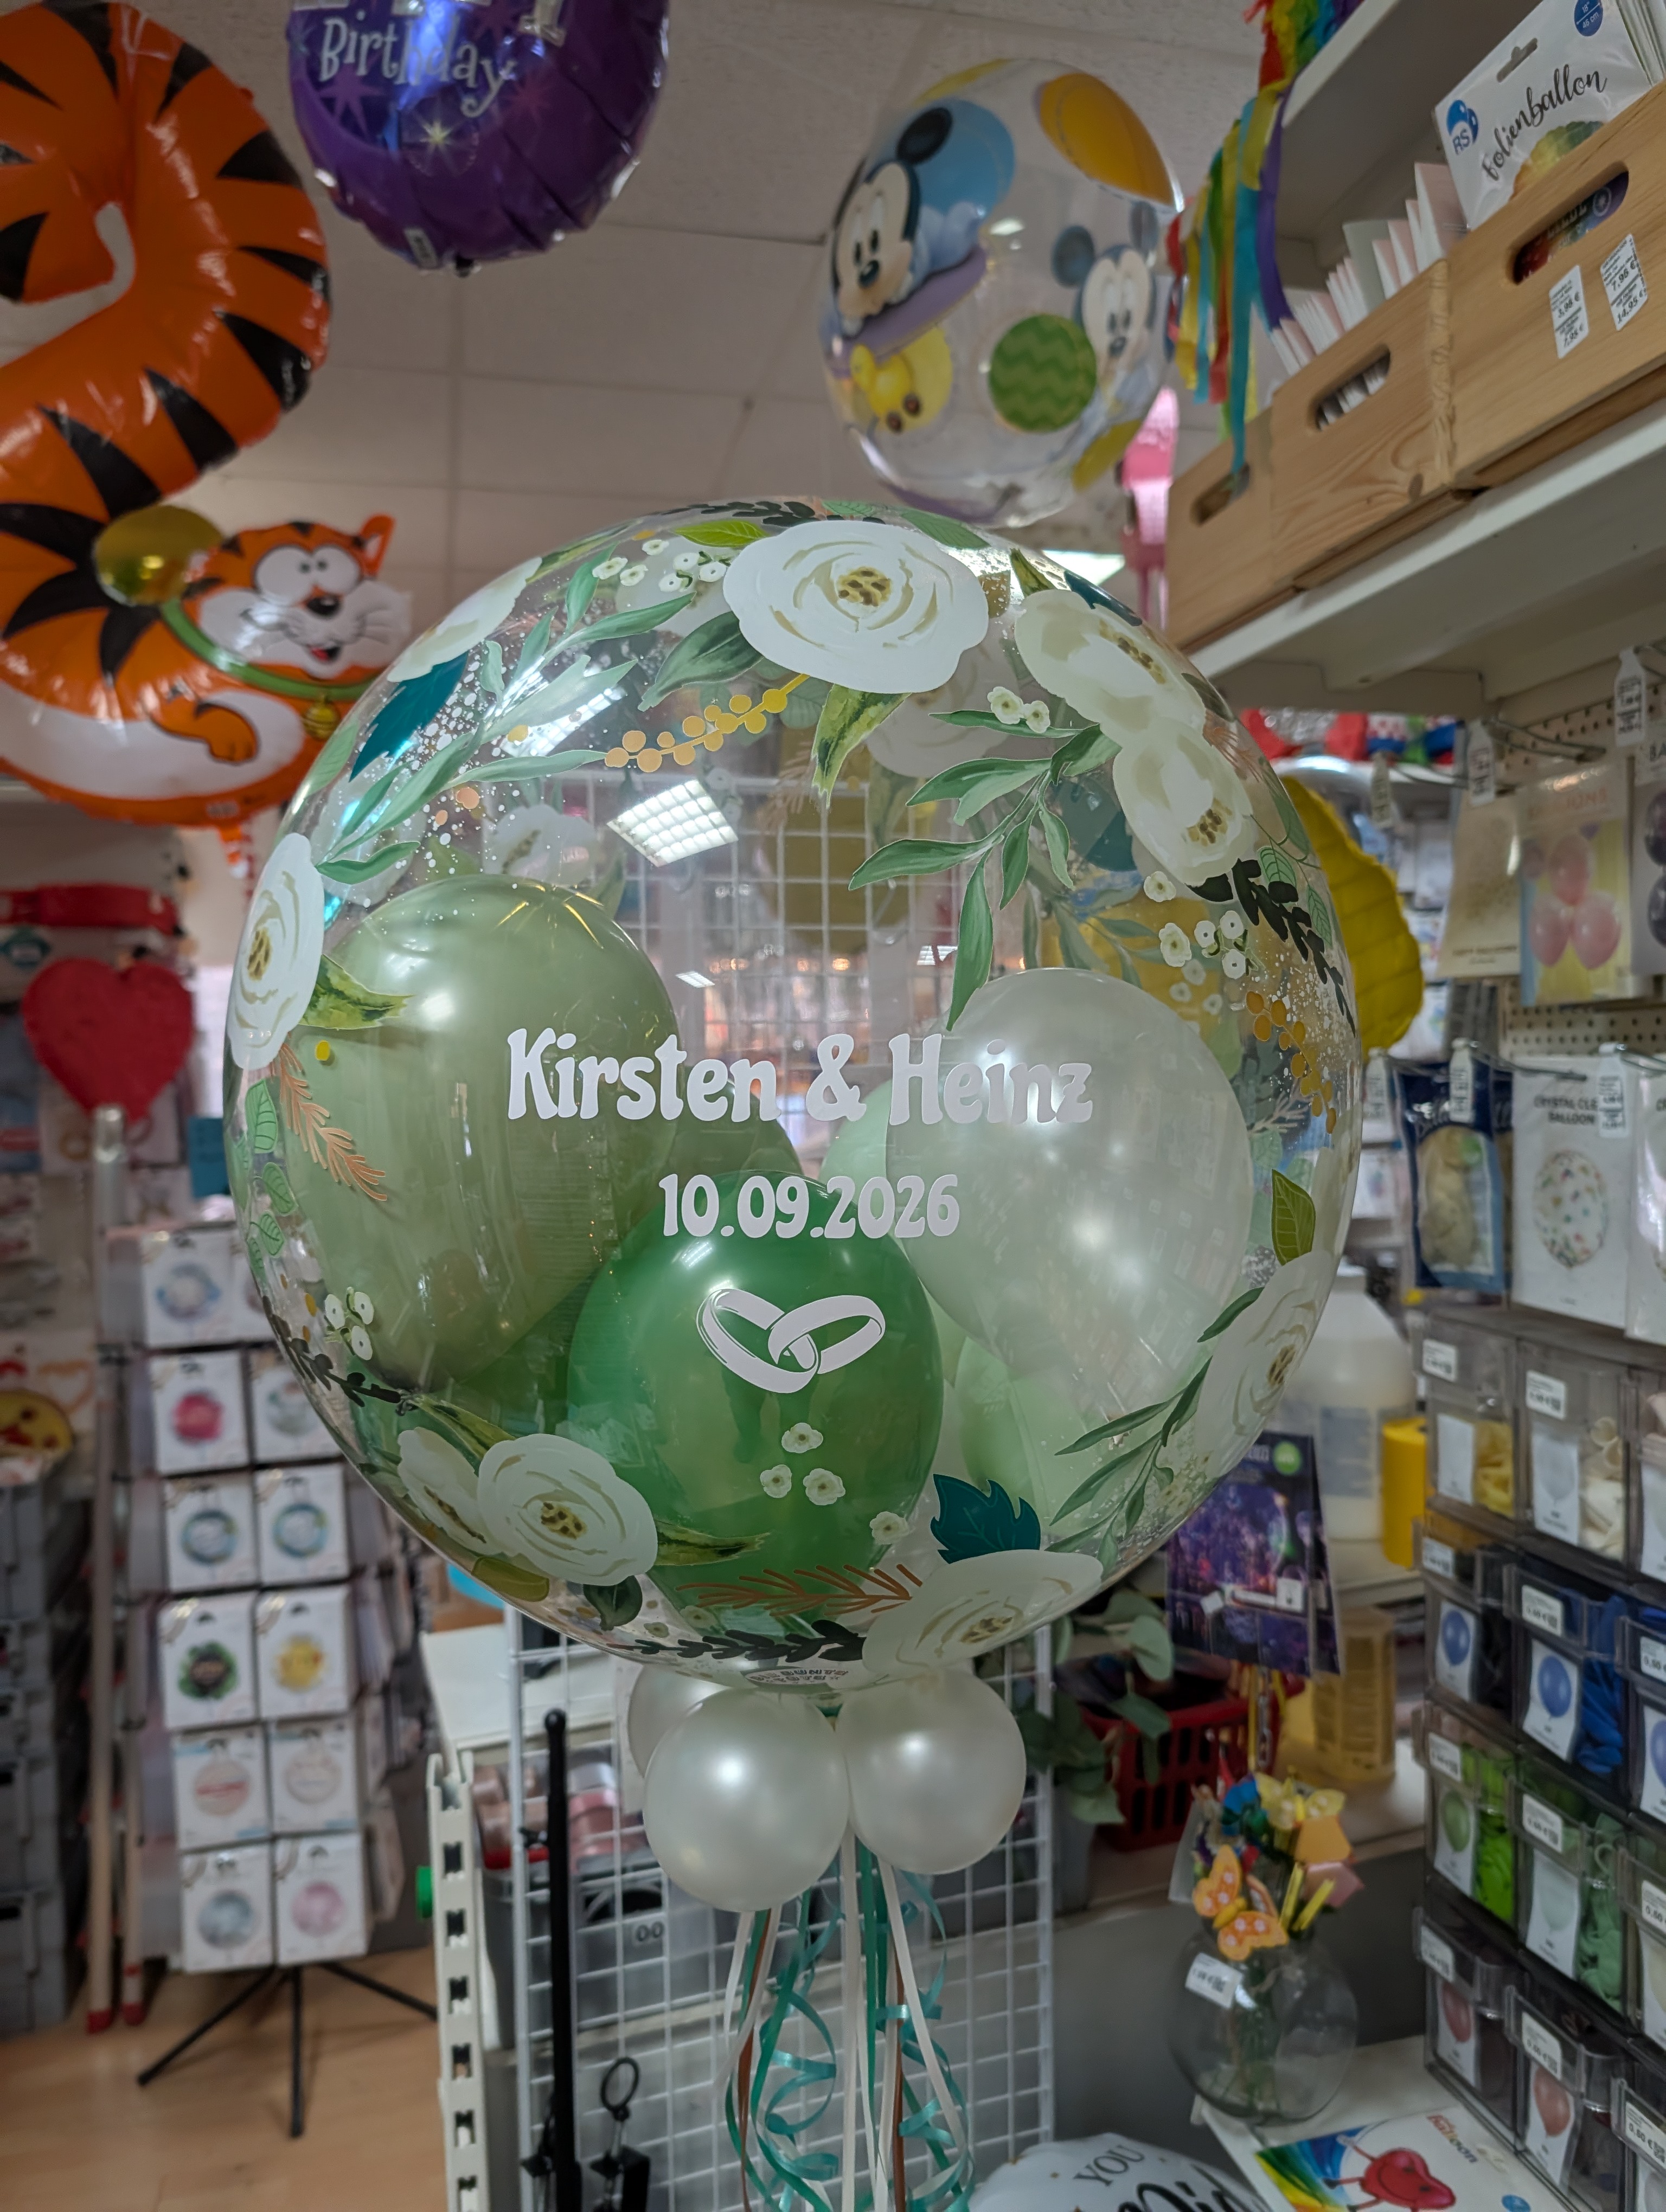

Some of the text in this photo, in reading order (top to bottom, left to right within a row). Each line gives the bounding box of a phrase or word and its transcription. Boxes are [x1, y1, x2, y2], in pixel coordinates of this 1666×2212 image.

[1582, 12, 1599, 28] 46 cm
[319, 10, 517, 118] Birthday
[1452, 129, 1470, 155] RS
[507, 1027, 1092, 1126] Kirsten & Heinz
[1548, 1111, 1595, 1126] BALLOON
[658, 1173, 960, 1239] 10.09.2026
[1073, 2144, 1145, 2187] YOU
